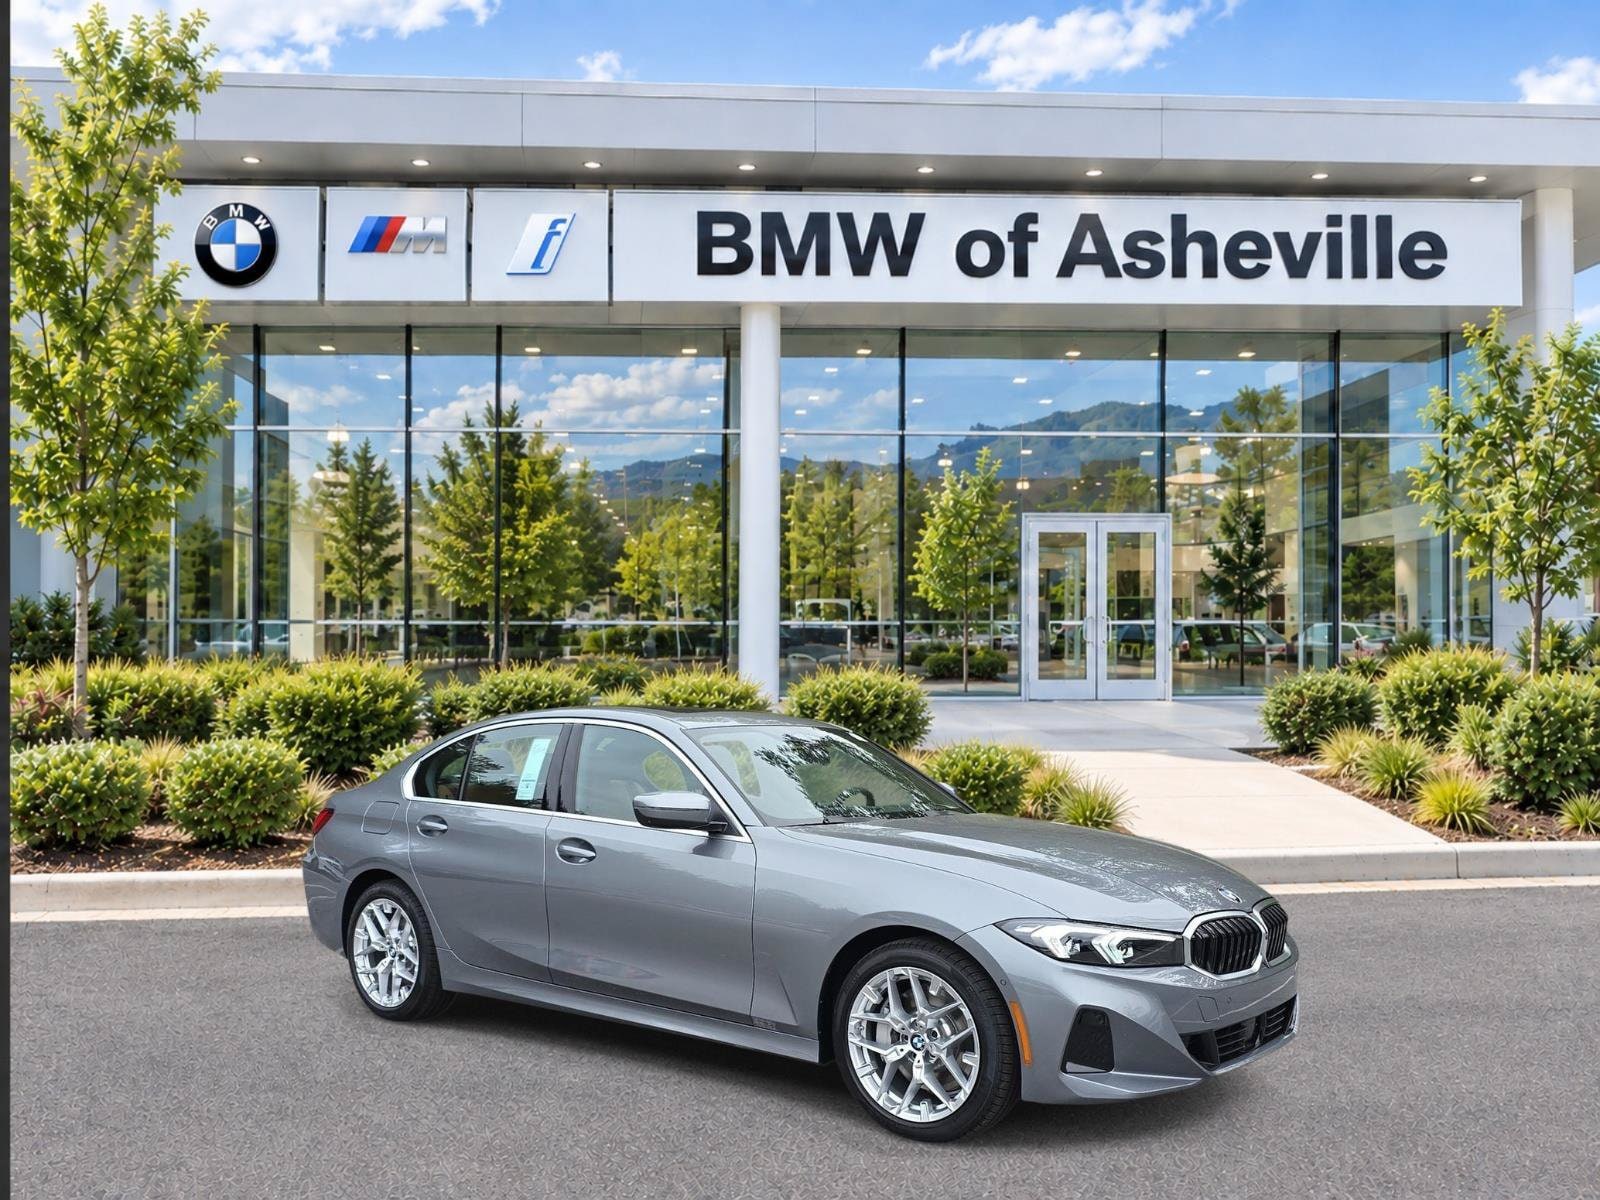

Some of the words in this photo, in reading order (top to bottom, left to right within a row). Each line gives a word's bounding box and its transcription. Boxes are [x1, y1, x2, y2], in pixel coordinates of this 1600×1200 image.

[202, 204, 271, 231] BMW
[696, 210, 926, 277] BMW
[955, 212, 1039, 279] of
[1056, 213, 1449, 281] Asheville
